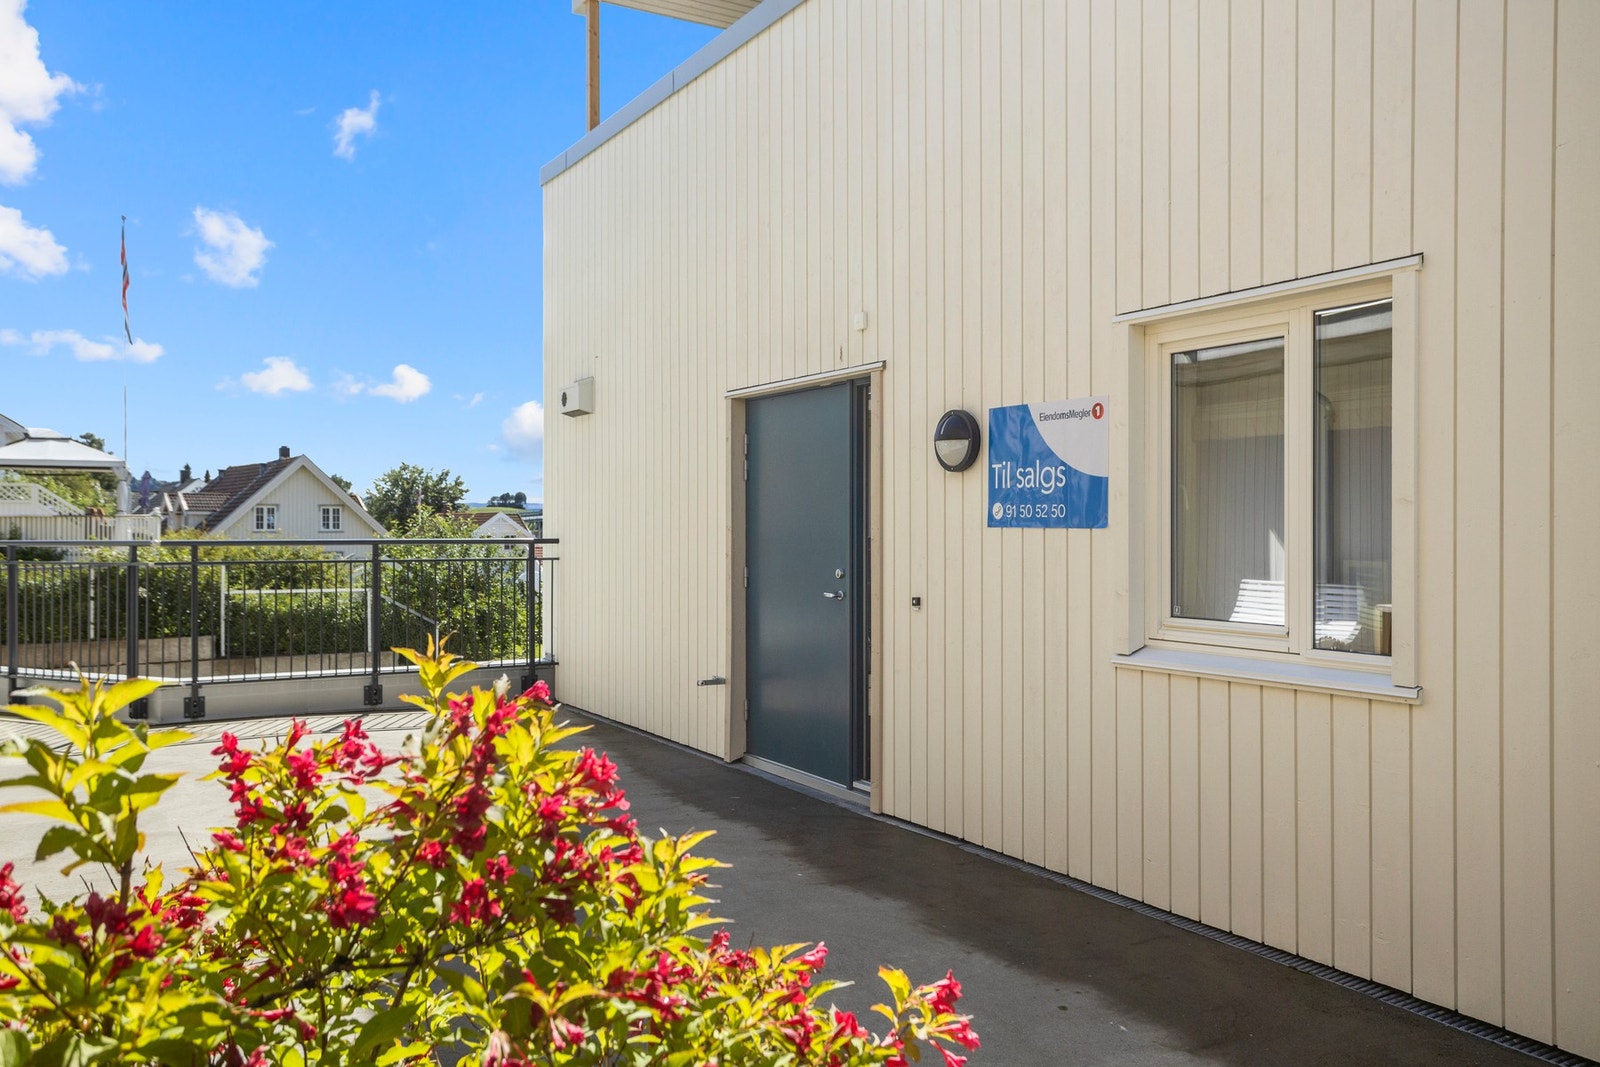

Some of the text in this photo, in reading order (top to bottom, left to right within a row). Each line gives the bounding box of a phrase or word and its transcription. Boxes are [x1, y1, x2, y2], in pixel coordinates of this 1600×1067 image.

[1039, 409, 1091, 421] EiendomsMegler
[991, 460, 1066, 494] Til salgs
[1005, 503, 1066, 518] 91 50 52 50
